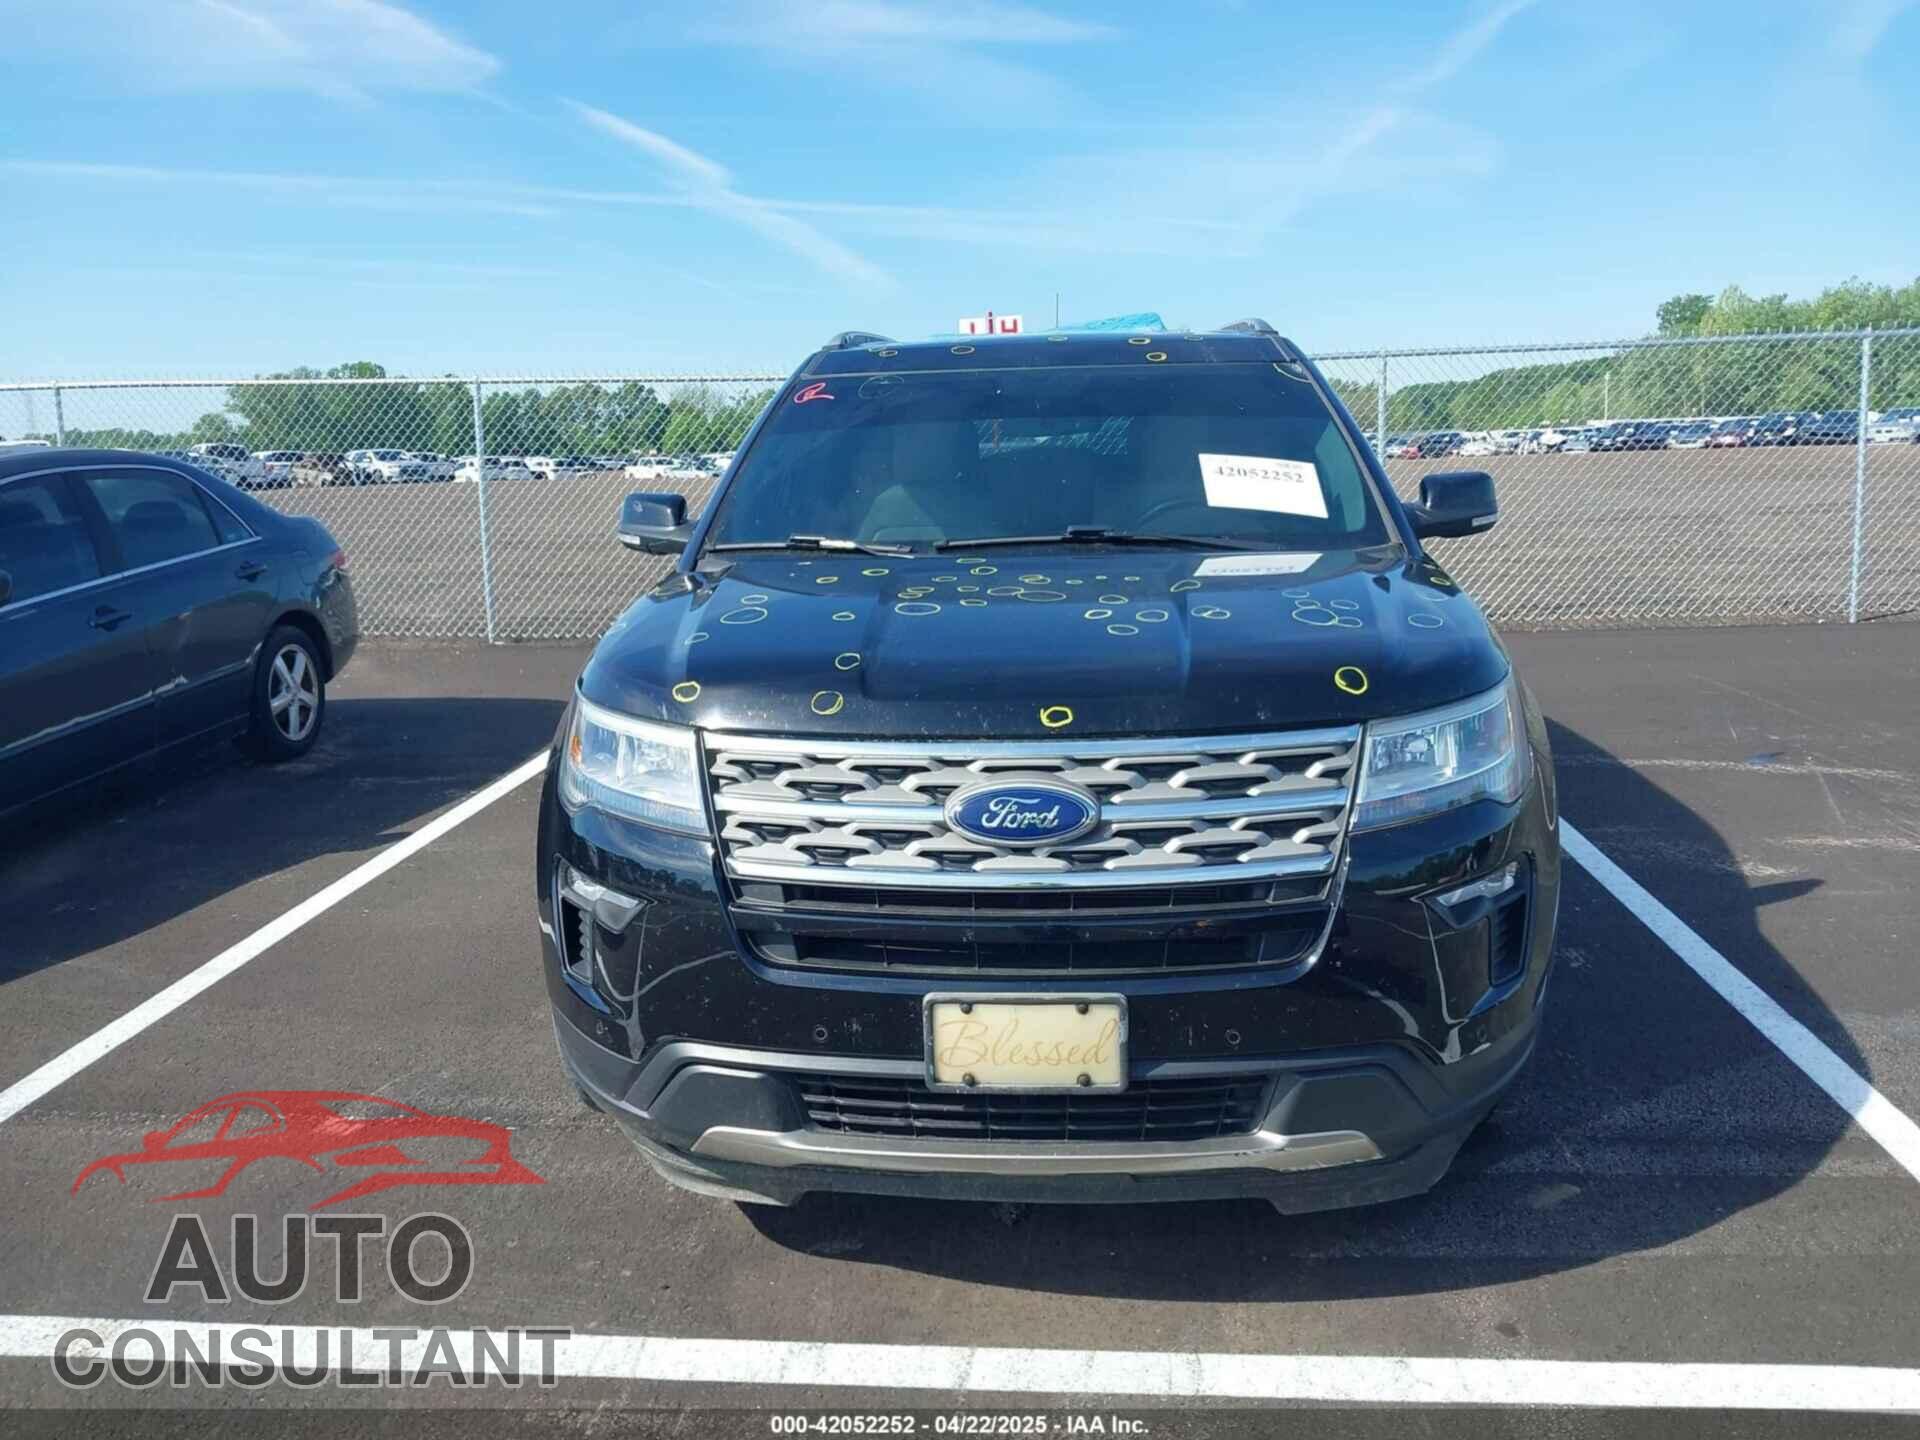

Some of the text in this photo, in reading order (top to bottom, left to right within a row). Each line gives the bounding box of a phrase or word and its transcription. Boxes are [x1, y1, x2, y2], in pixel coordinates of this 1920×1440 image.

[1215, 464, 1305, 485] 42052252
[981, 796, 1061, 829] Ford
[936, 1016, 1120, 1068] Blessed
